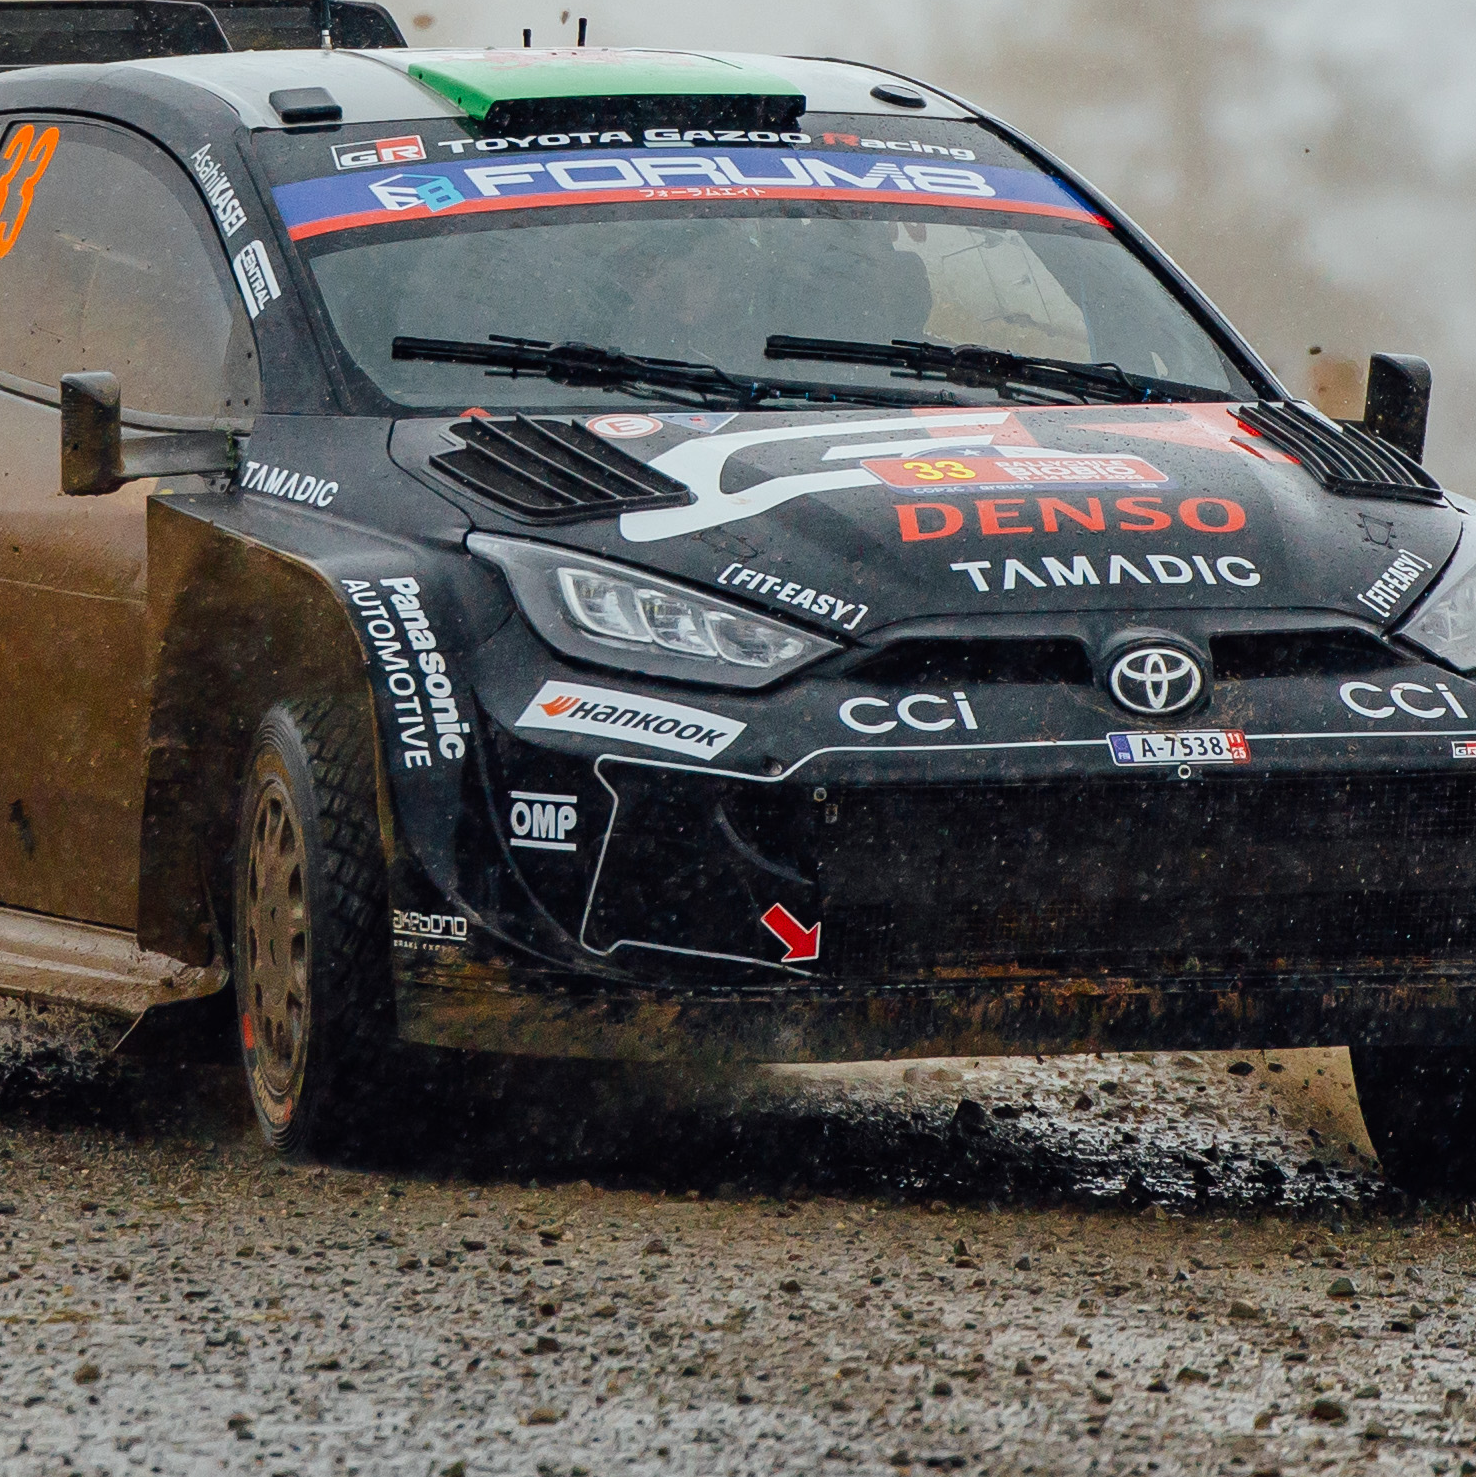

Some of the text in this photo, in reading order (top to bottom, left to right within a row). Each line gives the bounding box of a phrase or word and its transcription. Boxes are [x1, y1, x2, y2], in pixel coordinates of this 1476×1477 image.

[340, 128, 975, 167] GR TOYOTA GAZOO Racing
[190, 143, 247, 238] AsahiKASEI
[464, 156, 996, 197] FORUM8
[638, 187, 766, 199] フォーラムエイト
[240, 244, 271, 311] CENTRAL
[240, 460, 339, 507] TAMADIC
[903, 460, 976, 480] 33
[896, 497, 1246, 542] DENSO
[950, 554, 1261, 592] TAMADIC
[341, 579, 432, 768] AUTOMOTIVE
[380, 577, 471, 759] Panasonic
[1141, 736, 1224, 758] A-7538
[1227, 733, 1241, 743] 11
[510, 801, 577, 840] OMP
